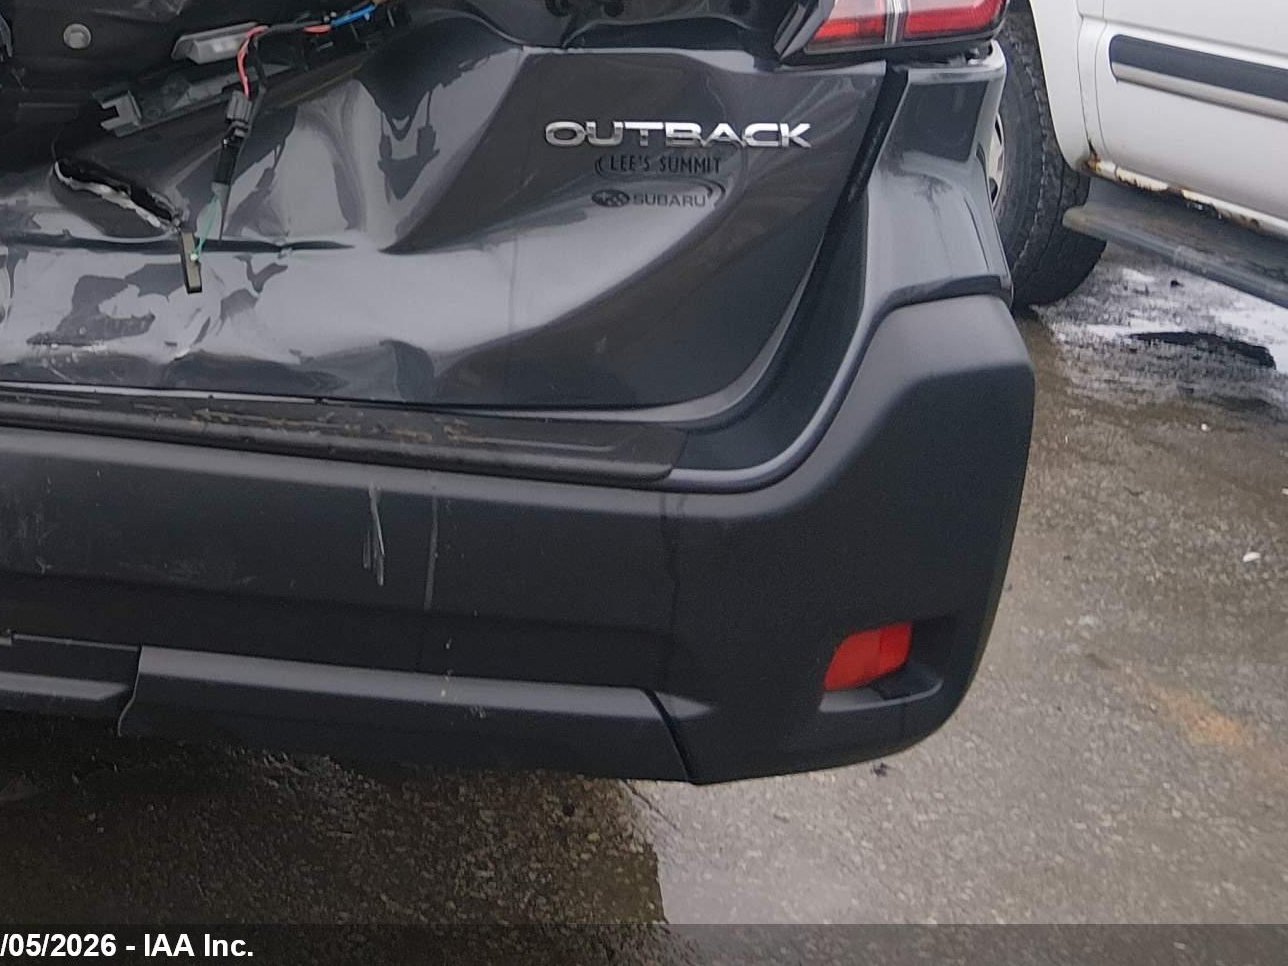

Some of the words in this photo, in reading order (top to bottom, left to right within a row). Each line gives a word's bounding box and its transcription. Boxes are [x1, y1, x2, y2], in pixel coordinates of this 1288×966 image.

[544, 120, 812, 149] OUTBACK
[610, 155, 651, 173] LEE'S
[658, 156, 723, 175] SUMMIT
[632, 188, 706, 208] SUBARU
